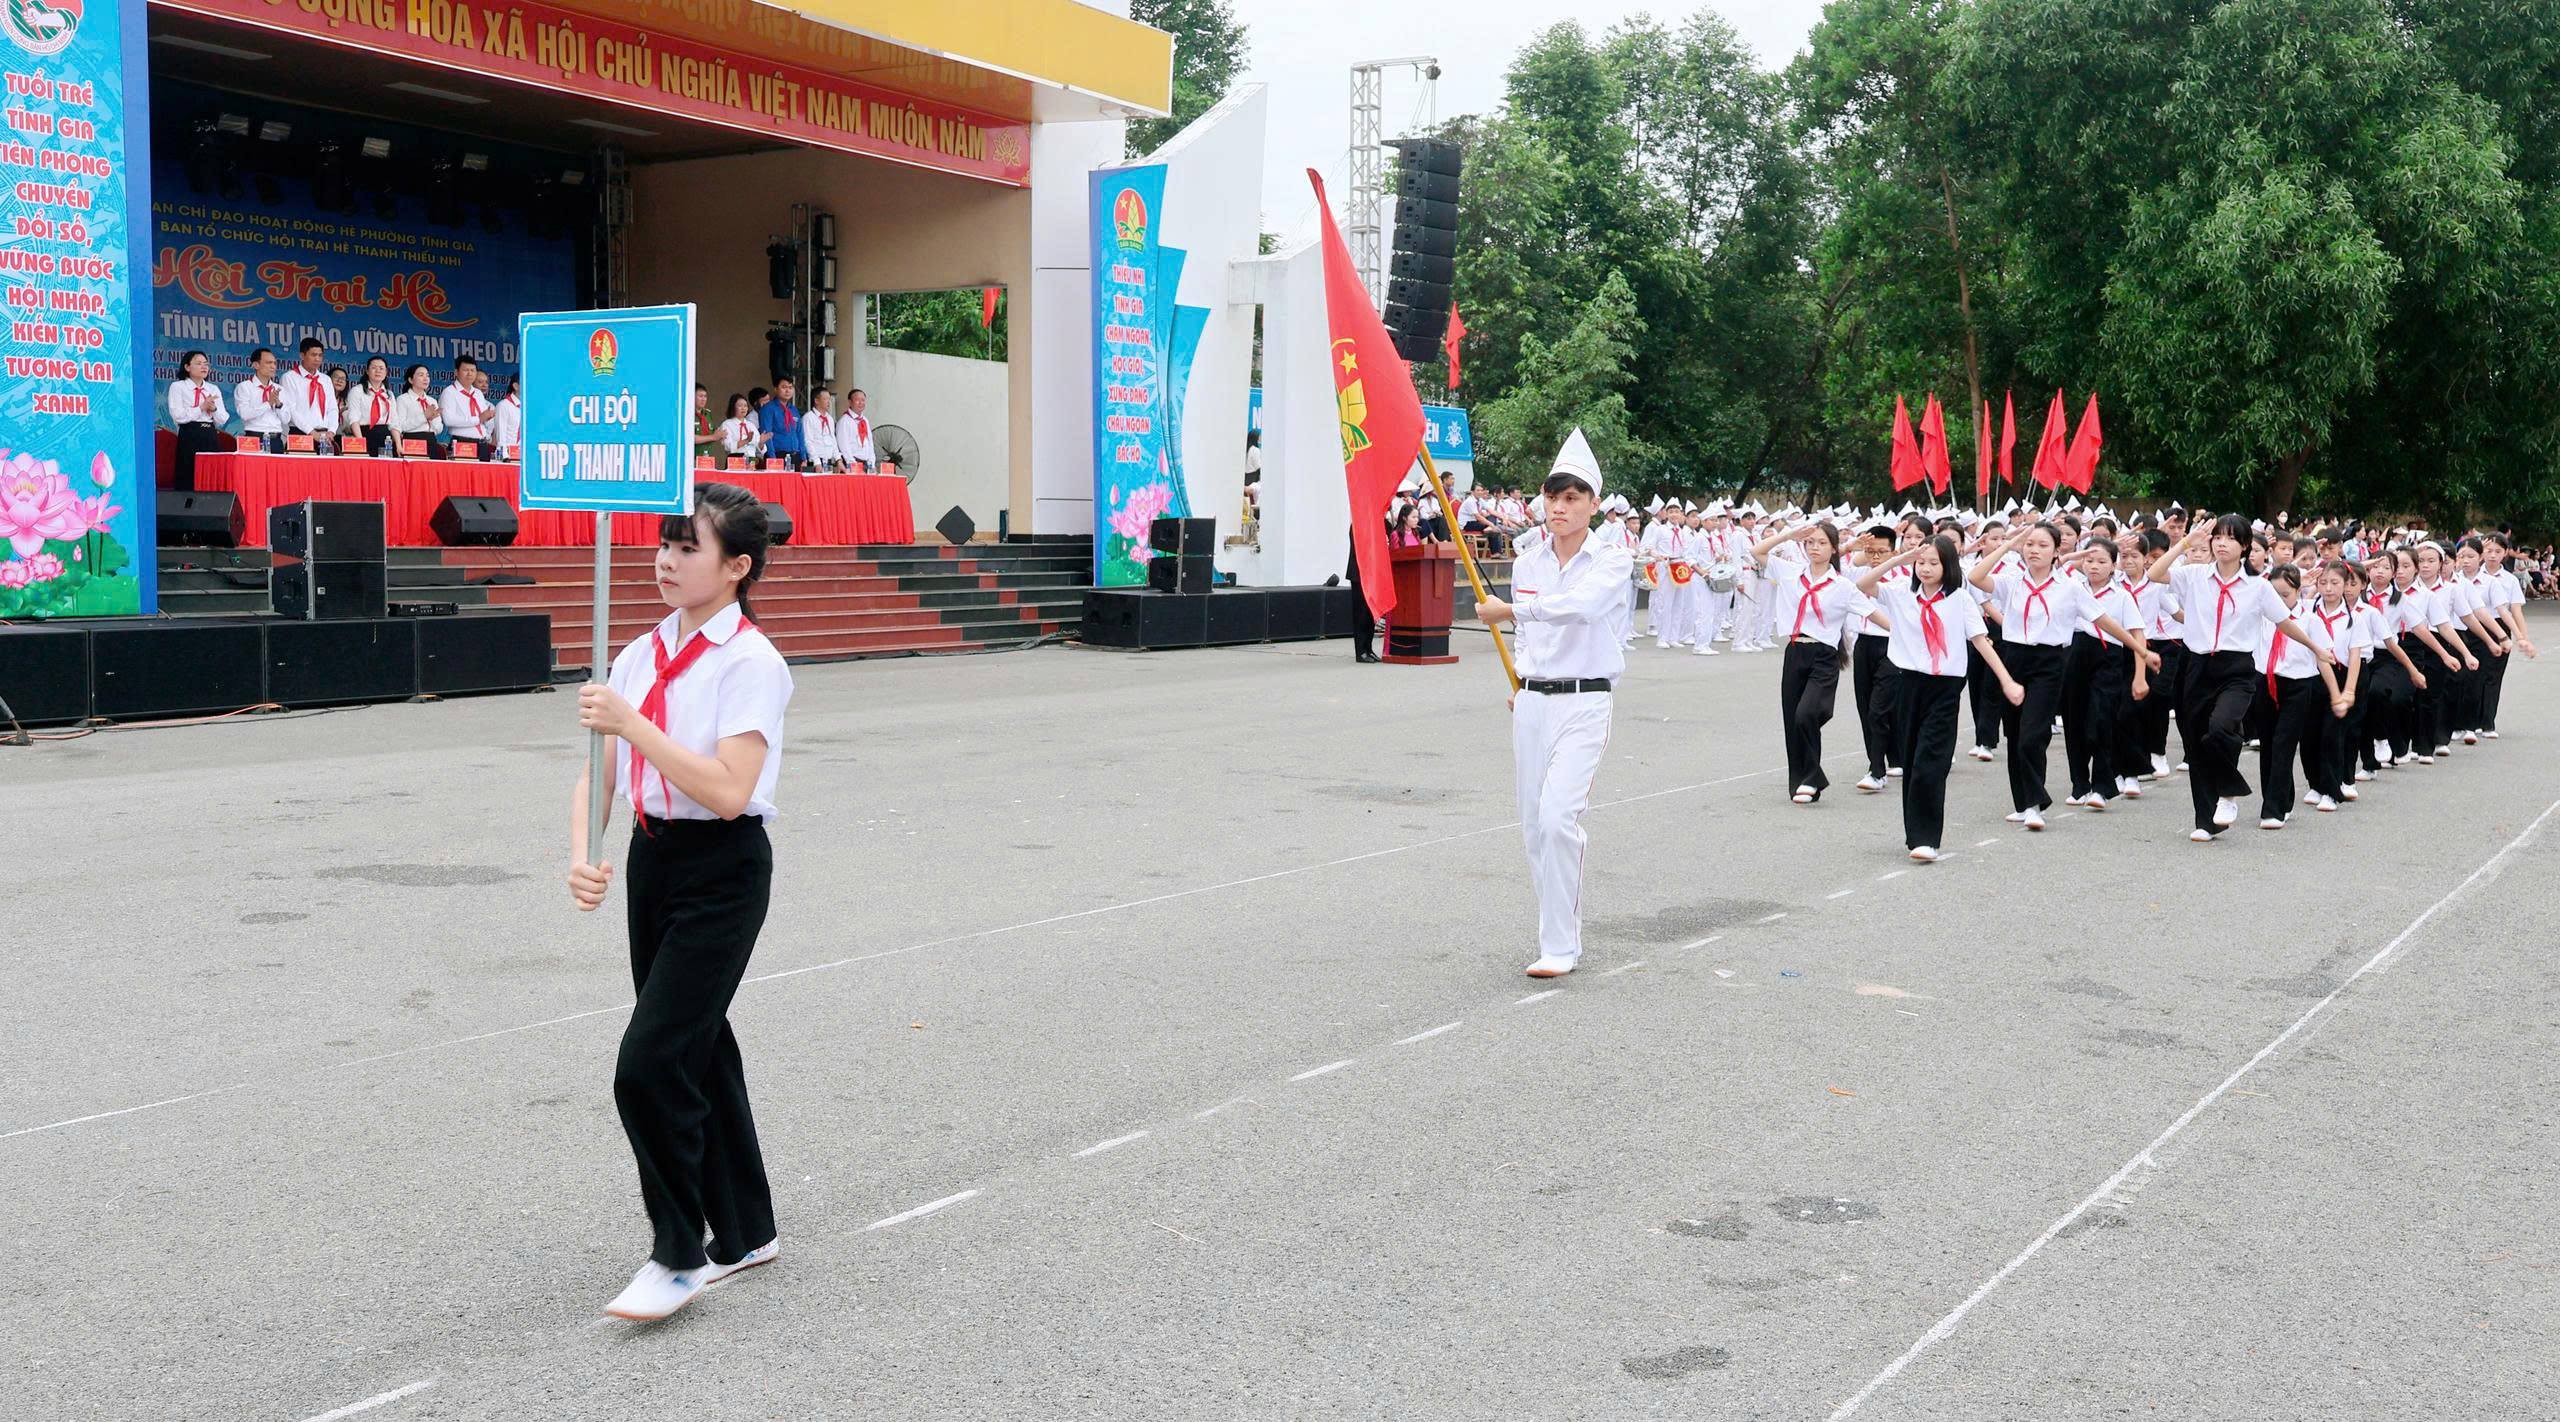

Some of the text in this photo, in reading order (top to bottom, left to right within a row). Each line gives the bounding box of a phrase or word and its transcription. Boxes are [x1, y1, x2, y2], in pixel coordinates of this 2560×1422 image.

[5, 68, 93, 106] TUỔI TRẺ
[483, 8, 528, 60] XÃ
[537, 19, 587, 79] HỘI
[596, 31, 651, 88] CHỦ
[661, 57, 743, 109] NGHĨA
[749, 71, 800, 124] VIỆT
[806, 87, 862, 135] NAM
[868, 102, 932, 150] MUÔN
[938, 115, 985, 161] NĂM
[7, 105, 94, 141] TĨNH GIA
[0, 140, 111, 177] IÊN PHONG
[16, 179, 91, 209] CHUYỂN
[16, 210, 92, 248] ĐỔI SỐ,
[152, 202, 173, 214] AN
[211, 210, 245, 225] ĐẠO
[249, 214, 289, 231] HOẠT
[293, 218, 336, 235] ĐỘNG
[360, 229, 416, 245] PHƯỜNG
[452, 242, 475, 253] GIA
[160, 221, 462, 267] BAN TỔ CHỨC HỘI TRẠI HÈ THANH THIẾU NHI
[0, 246, 113, 280] VỮNG BƯỚC
[8, 283, 105, 319] HỘI NHẬP,
[153, 243, 480, 329] Hội Trại Hè
[13, 314, 103, 353] KIẾN TẠO
[160, 310, 215, 341] TĨNH
[222, 318, 260, 345] GIA
[266, 322, 295, 351] TỰ
[300, 321, 347, 354] HÀO,
[353, 326, 408, 356] VỮNG
[413, 335, 445, 359] TIN
[450, 338, 497, 363] THEO
[5, 357, 112, 382] TƯƠNG LAI
[33, 393, 89, 414] XANH
[569, 387, 638, 431] CHI ĐỘI
[538, 443, 667, 482] TDP THANH NAM
